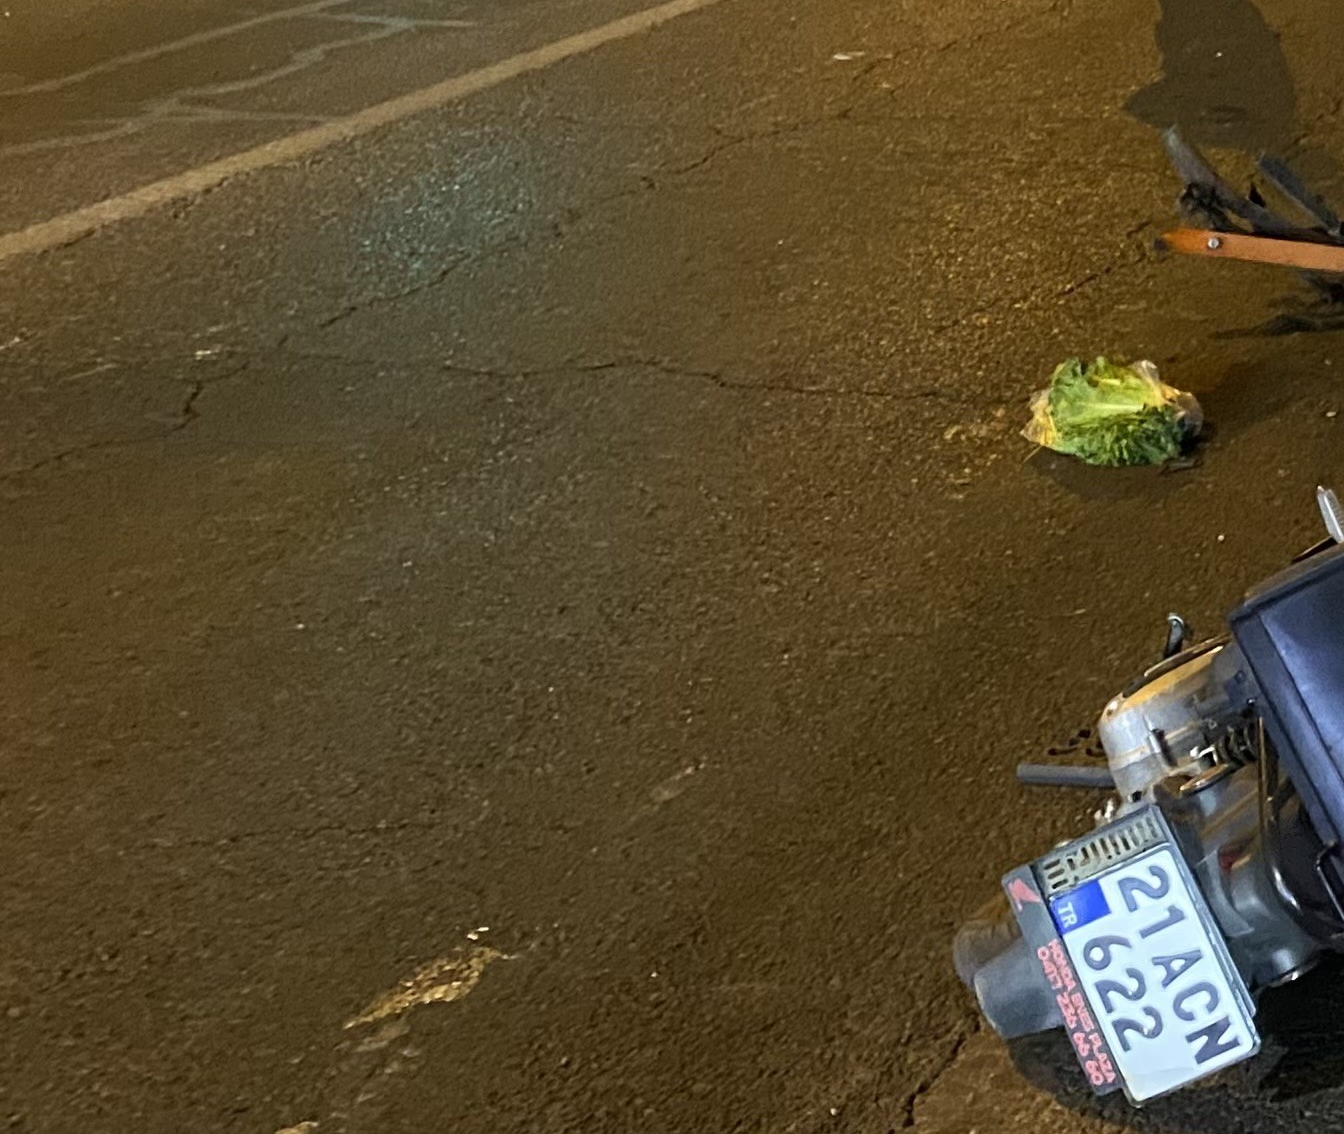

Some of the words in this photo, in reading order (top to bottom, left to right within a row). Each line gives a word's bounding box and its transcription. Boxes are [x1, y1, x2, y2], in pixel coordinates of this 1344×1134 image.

[1057, 901, 1078, 928] TR
[1117, 865, 1185, 939] 21
[1152, 949, 1241, 1065] ACN
[1048, 938, 1076, 992] HONDA
[1089, 1032, 1116, 1083] PLAZA
[1083, 935, 1164, 1052] 622
